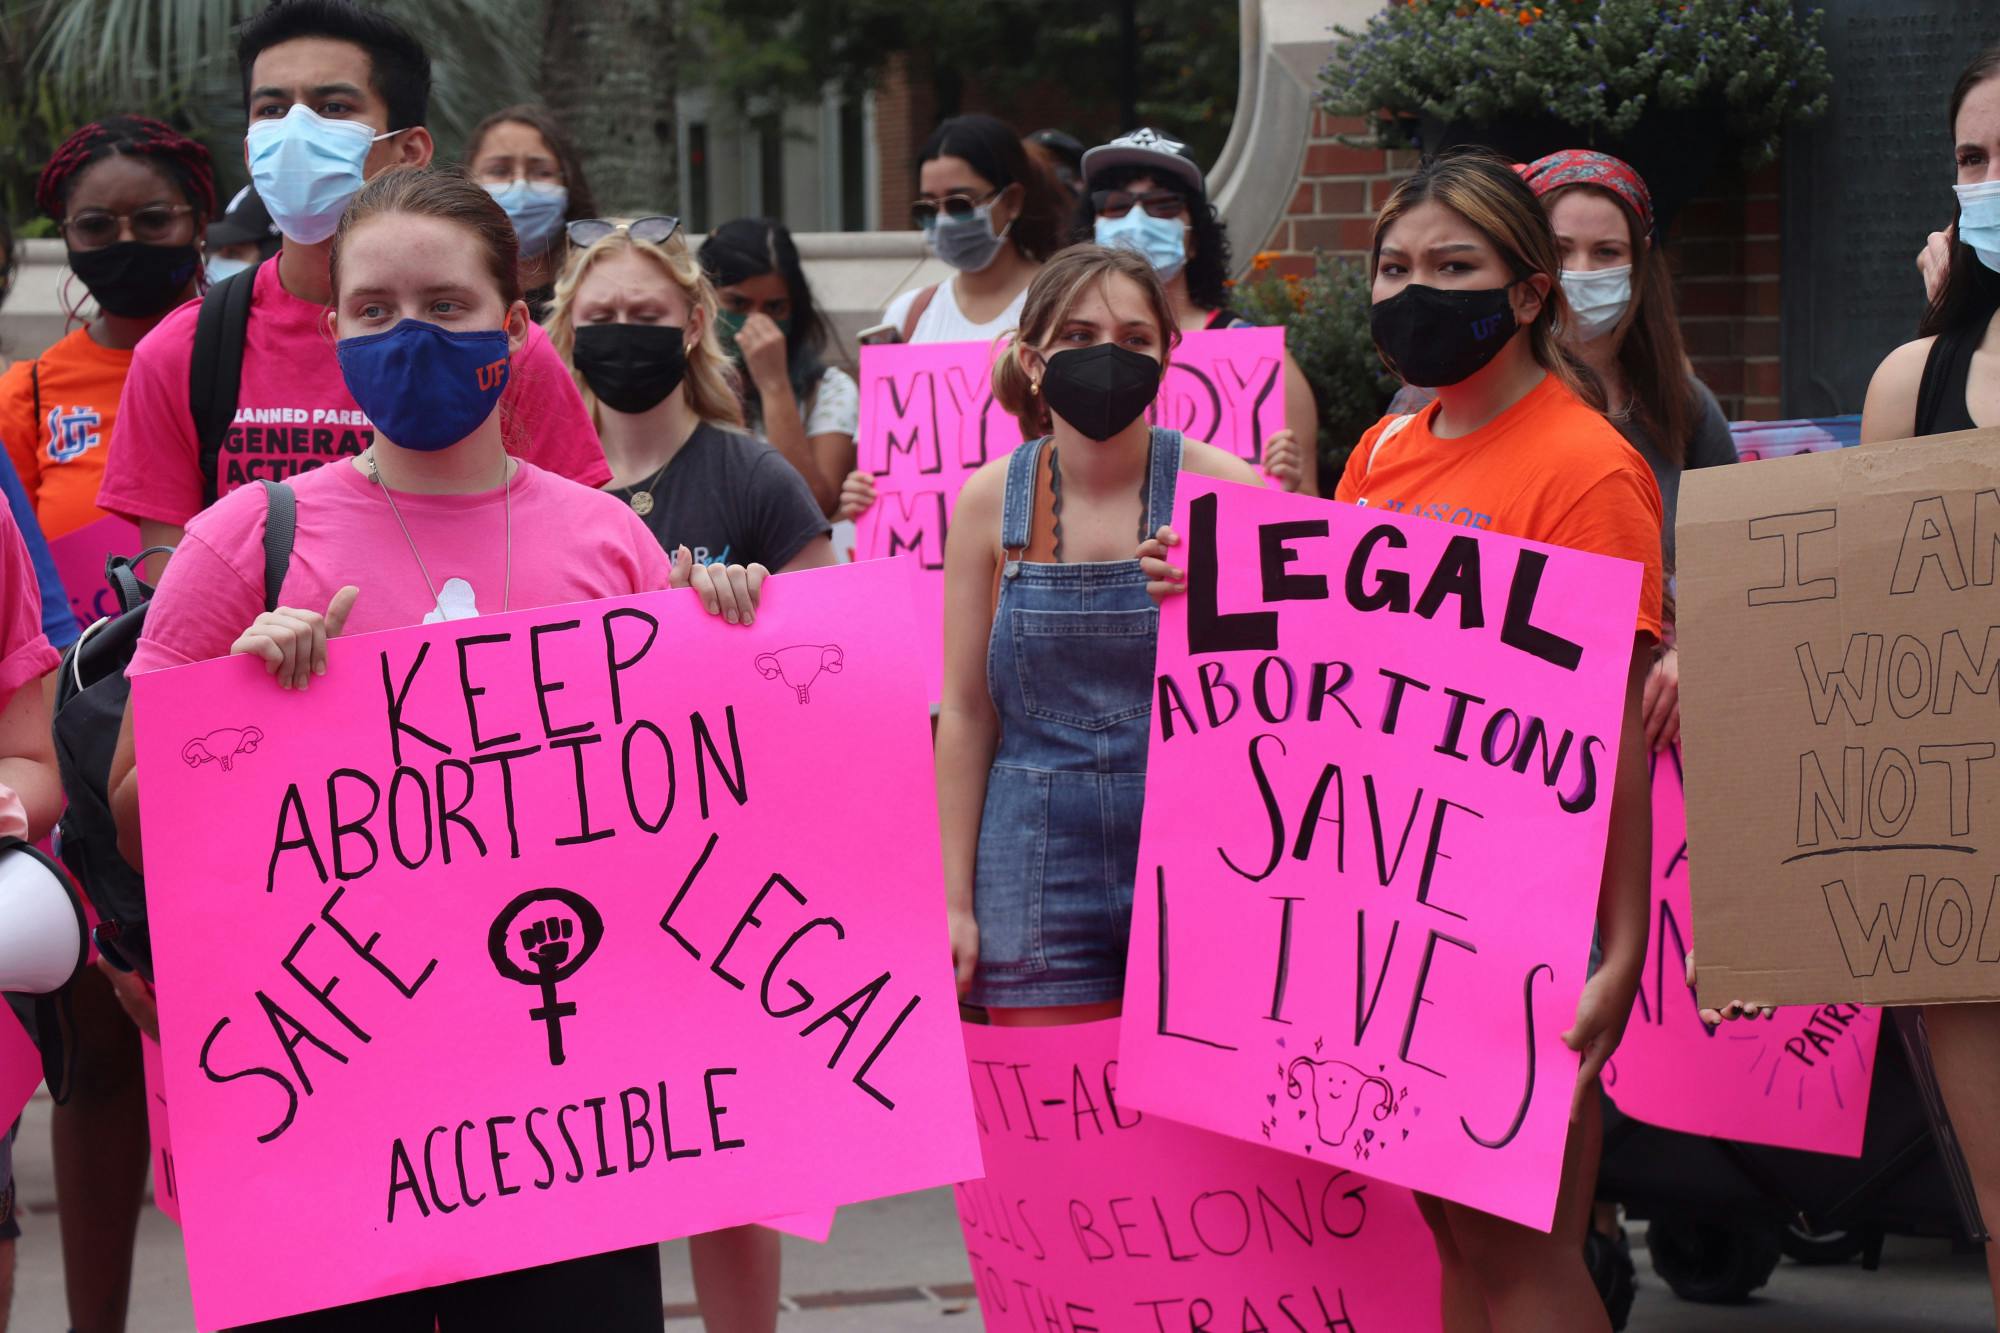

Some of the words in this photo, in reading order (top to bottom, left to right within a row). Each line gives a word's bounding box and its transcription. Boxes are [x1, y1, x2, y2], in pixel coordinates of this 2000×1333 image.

[475, 357, 506, 391] UF
[1470, 311, 1502, 341] UF
[870, 366, 994, 477] MY
[1143, 356, 1281, 465] DY
[870, 490, 949, 570] M
[1187, 492, 1583, 672] LEGAL
[1747, 508, 1837, 607] I
[381, 607, 658, 767] KEEP
[1157, 656, 1606, 815] ABORTIONS
[266, 705, 748, 893] ABORTION
[1217, 734, 1484, 921] SAVE
[1796, 742, 1996, 847] NOT
[199, 887, 438, 1143] SAFE
[659, 832, 921, 1111] LEGAL
[1156, 865, 1553, 1150] LIVES
[386, 1067, 745, 1223] ACCESSIBLE
[1068, 1169, 1368, 1263] BELONG
